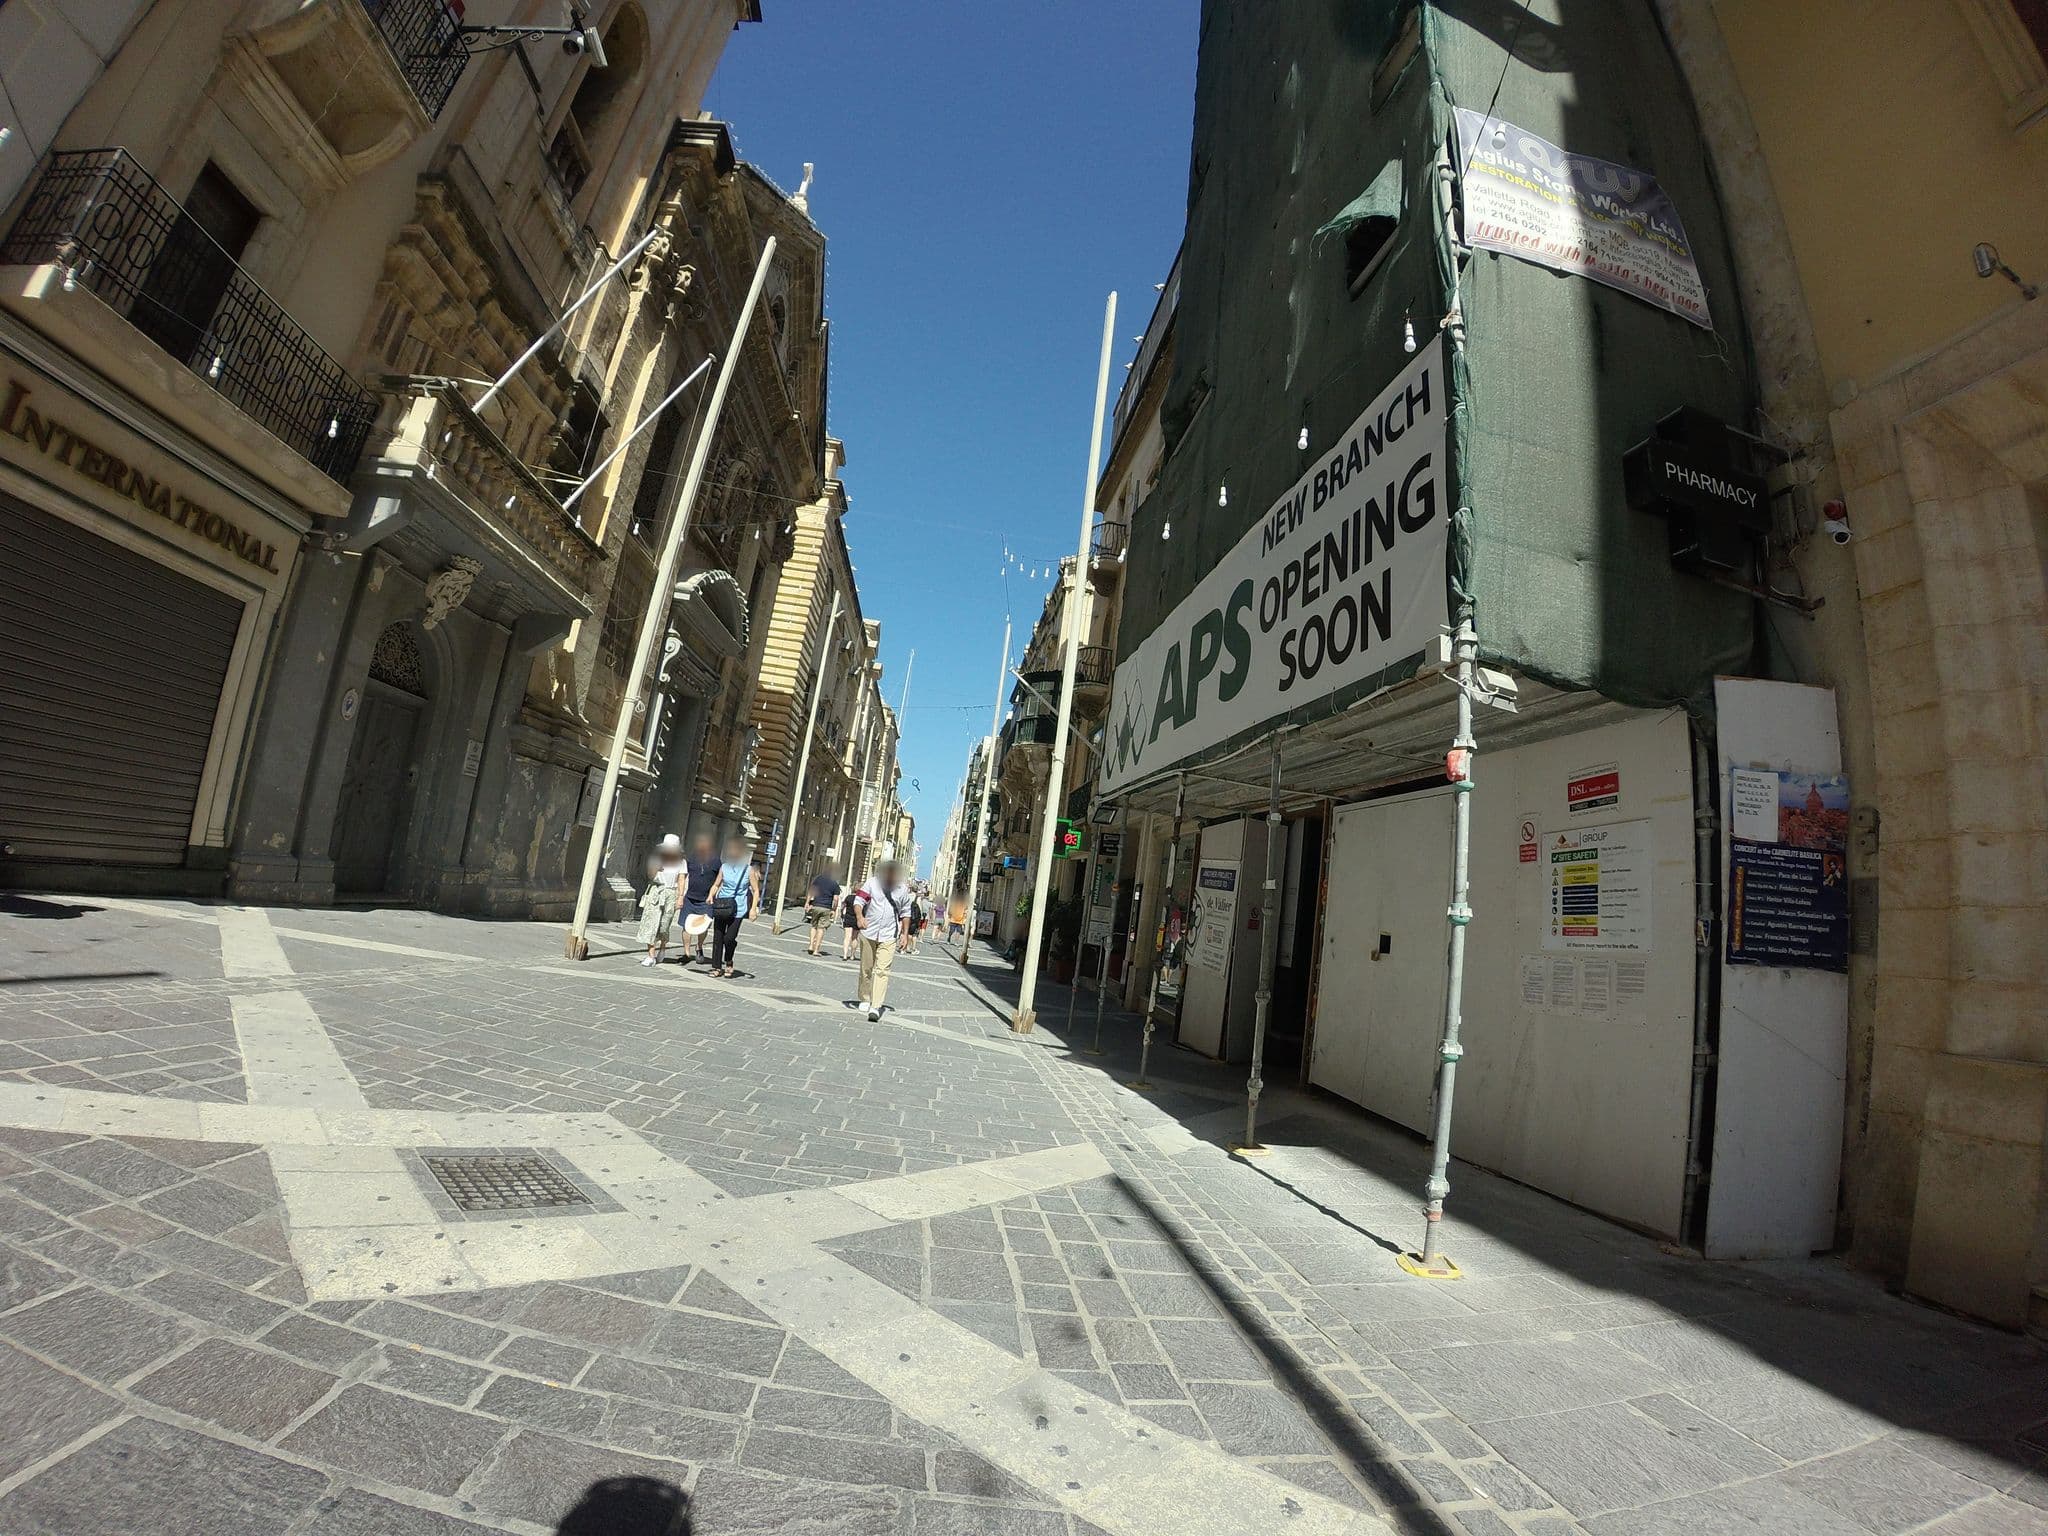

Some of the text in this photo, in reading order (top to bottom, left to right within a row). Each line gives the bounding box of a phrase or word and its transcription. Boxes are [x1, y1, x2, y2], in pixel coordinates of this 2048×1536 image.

[1468, 143, 1527, 174] Agius
[1468, 159, 1564, 203] RESTORATION
[1476, 222, 1541, 249] trusted
[1545, 242, 1581, 262] with
[1261, 369, 1432, 559] NEW BRANCH
[1665, 461, 1758, 509] PHARMACY
[1259, 452, 1436, 634] OPENING
[1278, 567, 1393, 693] SOON
[1148, 578, 1254, 746] APS
[1570, 783, 1588, 797] DSL
[1558, 853, 1572, 862] SITE
[1572, 850, 1597, 861] SAFETY
[1582, 831, 1608, 843] GROUP
[1092, 864, 1103, 905] PHARMACY
